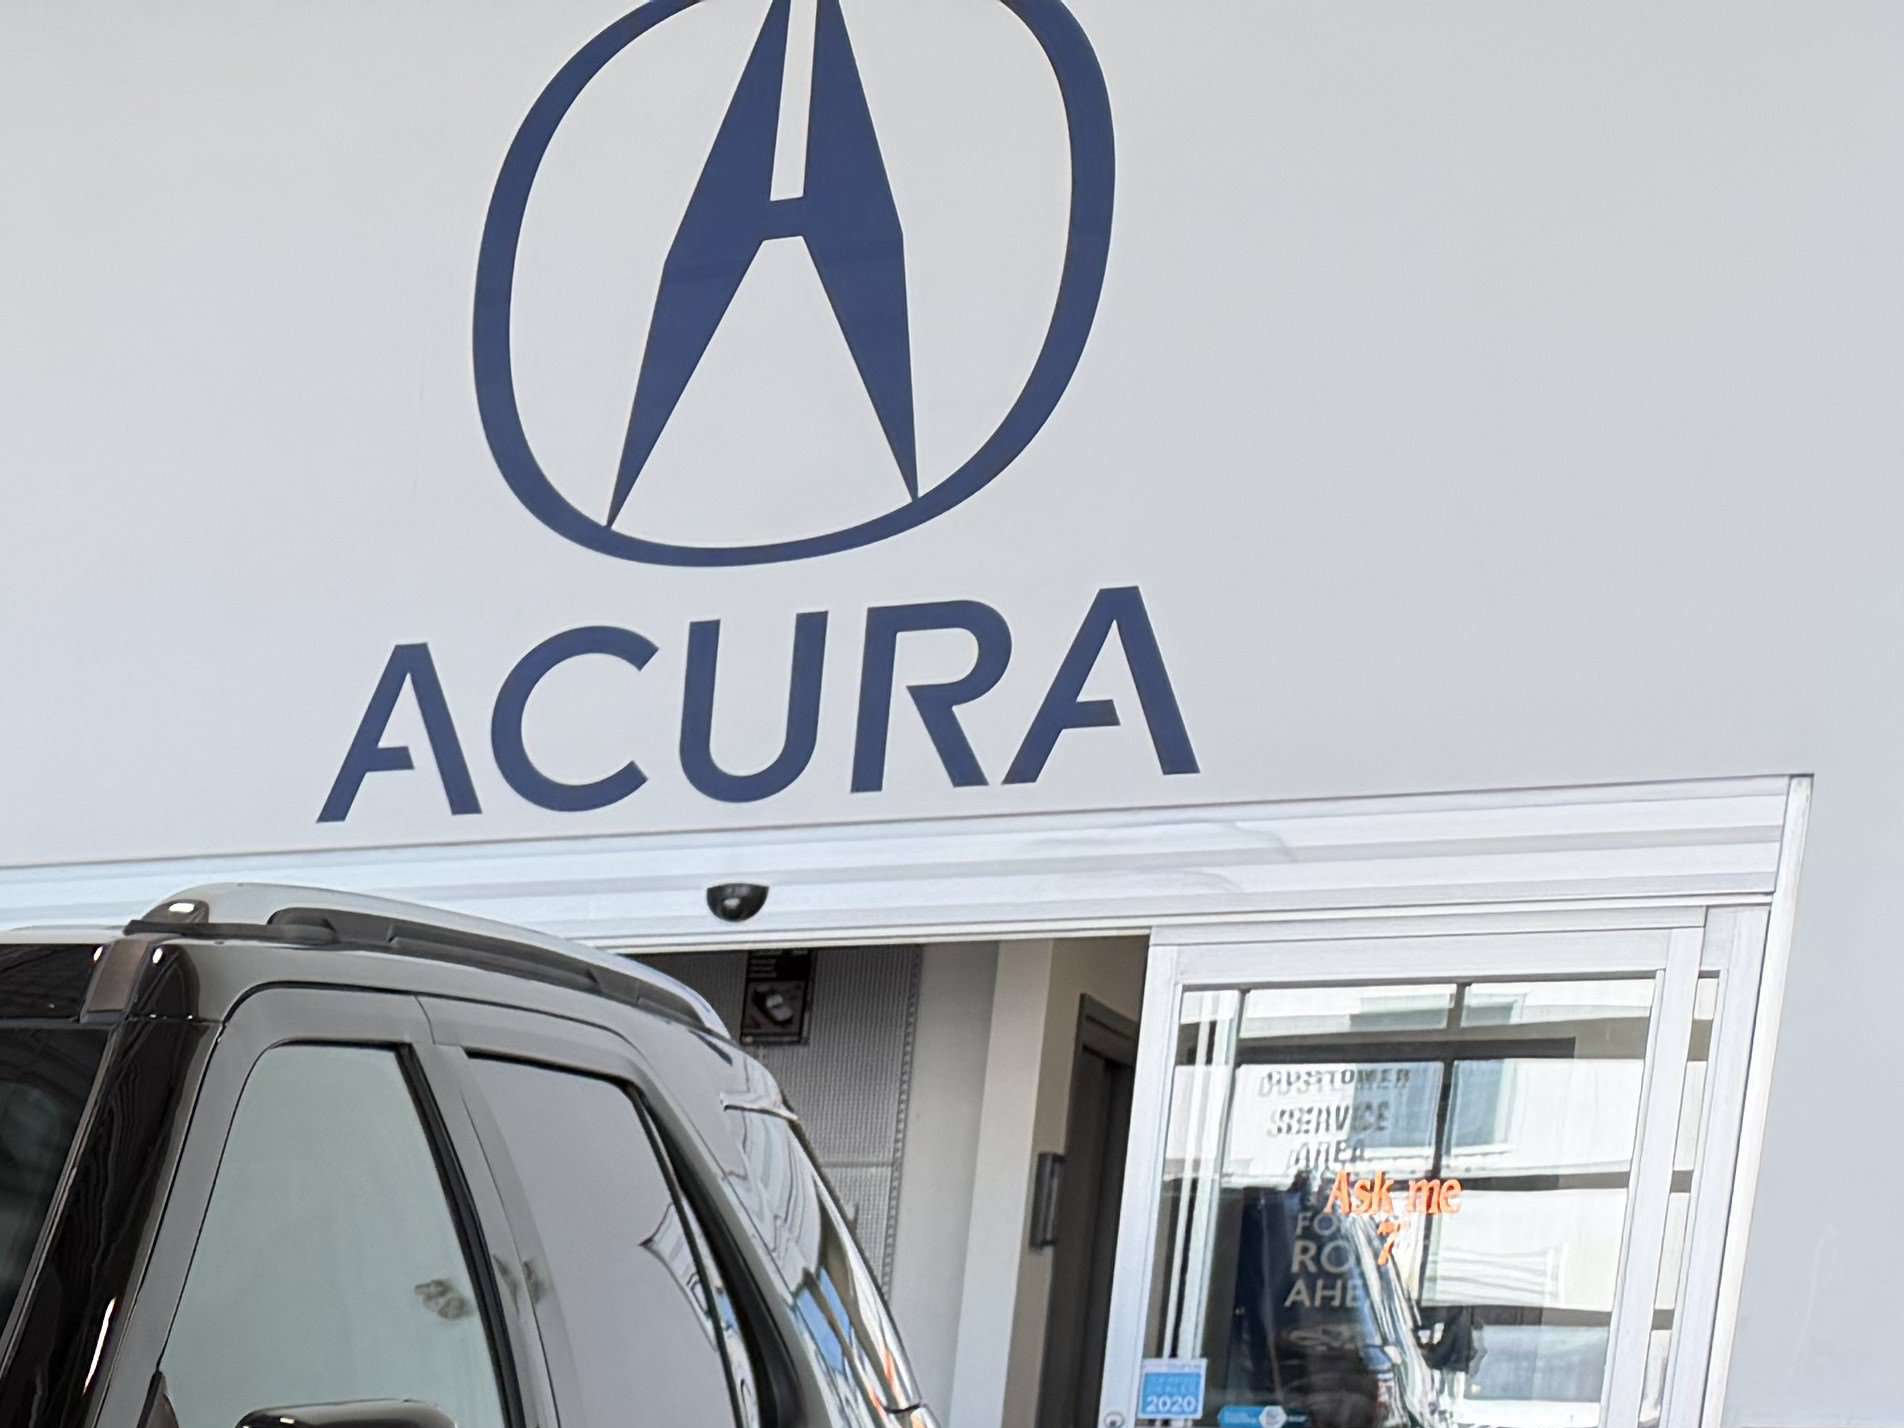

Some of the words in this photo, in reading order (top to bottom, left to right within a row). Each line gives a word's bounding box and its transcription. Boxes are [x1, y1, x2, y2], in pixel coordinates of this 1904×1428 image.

[317, 585, 1201, 824] ACURA
[1267, 1100, 1390, 1137] SERVICE
[1322, 1168, 1395, 1216] Ask
[1406, 1177, 1463, 1216] me
[1145, 1394, 1197, 1414] 2020
